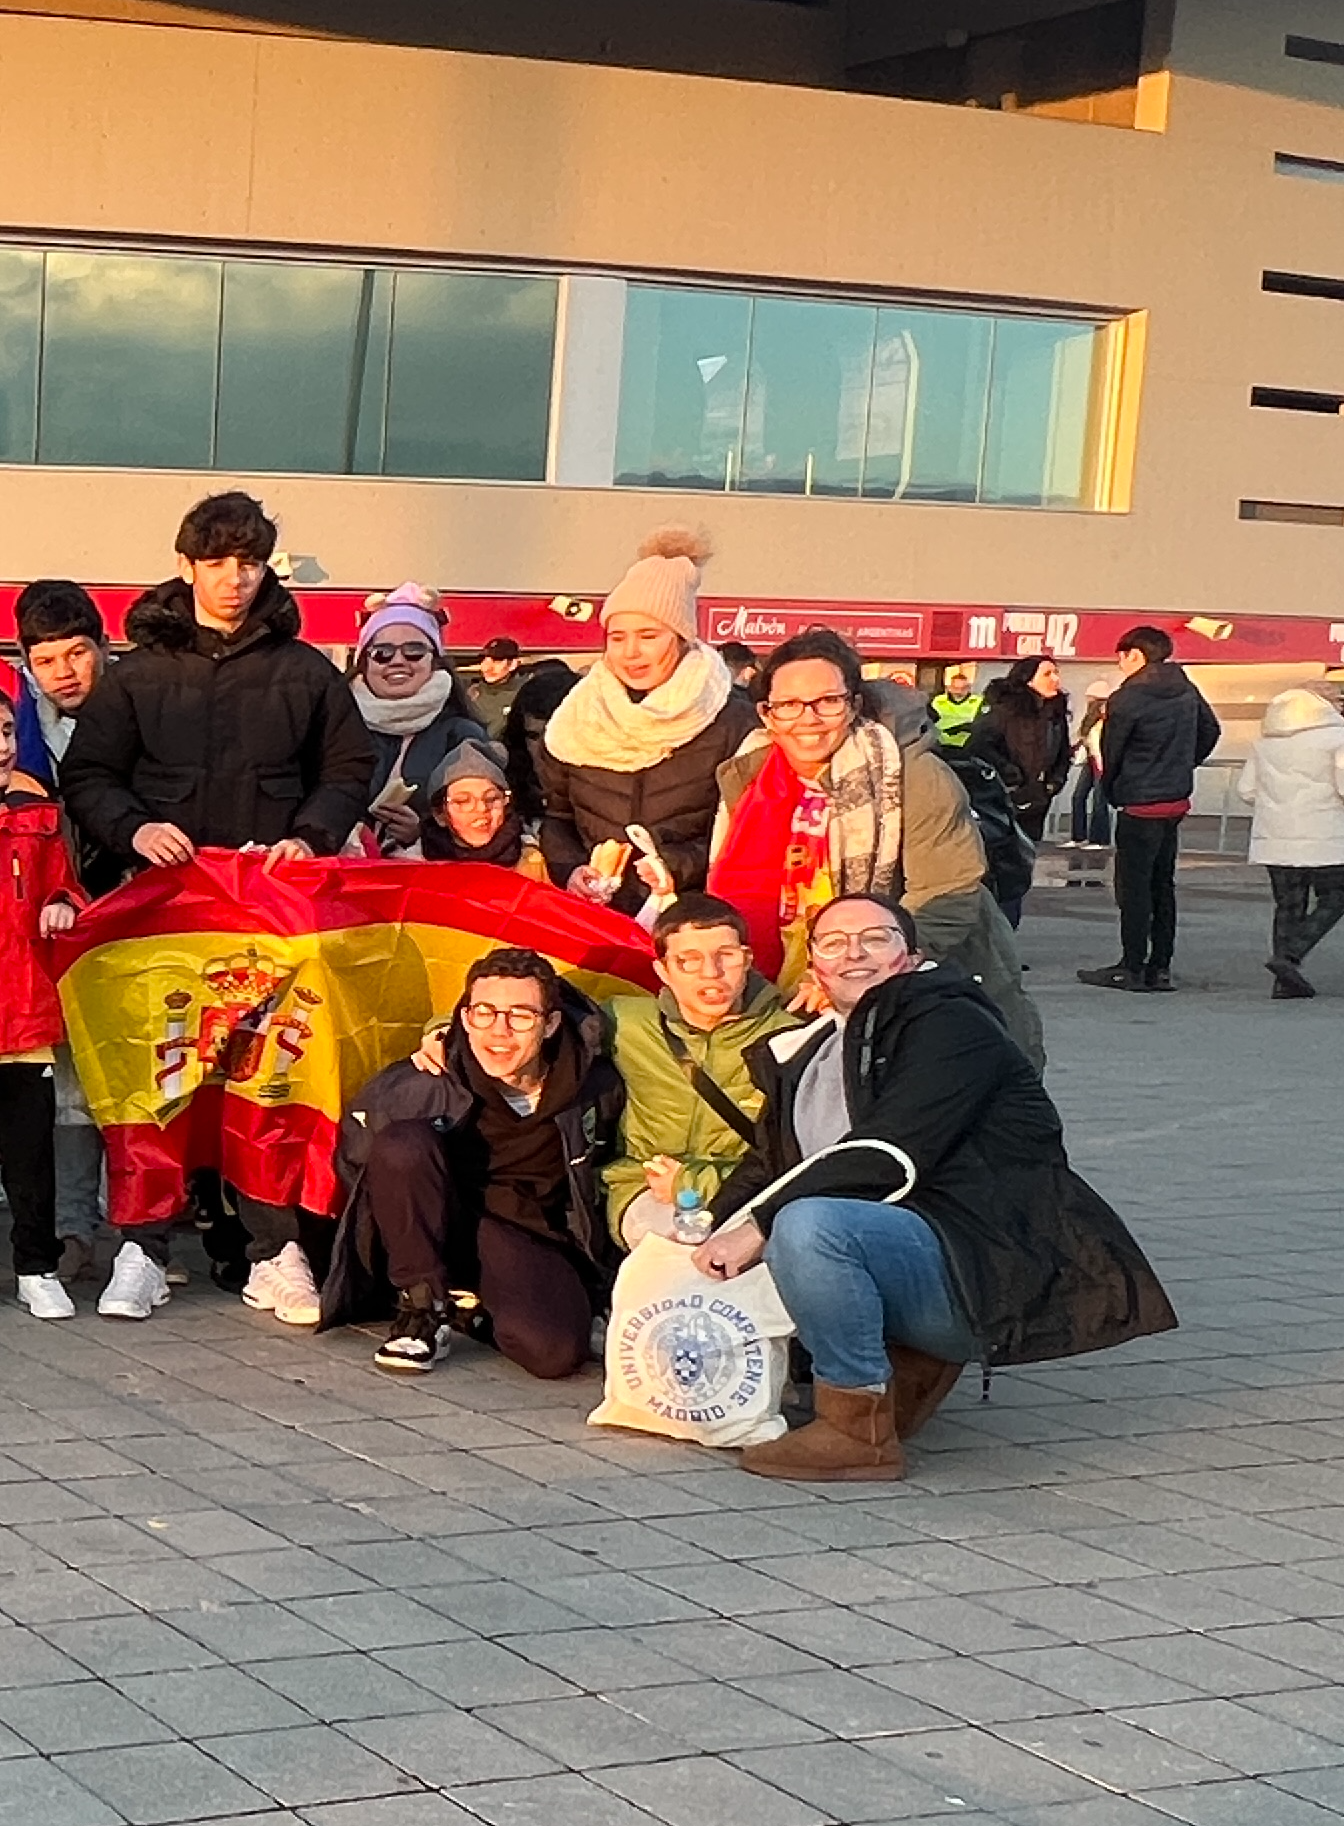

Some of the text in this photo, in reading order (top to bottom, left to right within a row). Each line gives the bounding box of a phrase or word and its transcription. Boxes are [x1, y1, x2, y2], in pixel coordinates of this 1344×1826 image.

[618, 1294, 764, 1407] UNIVERSIDAD COMPTENSE
[647, 1395, 726, 1422] MADRID
